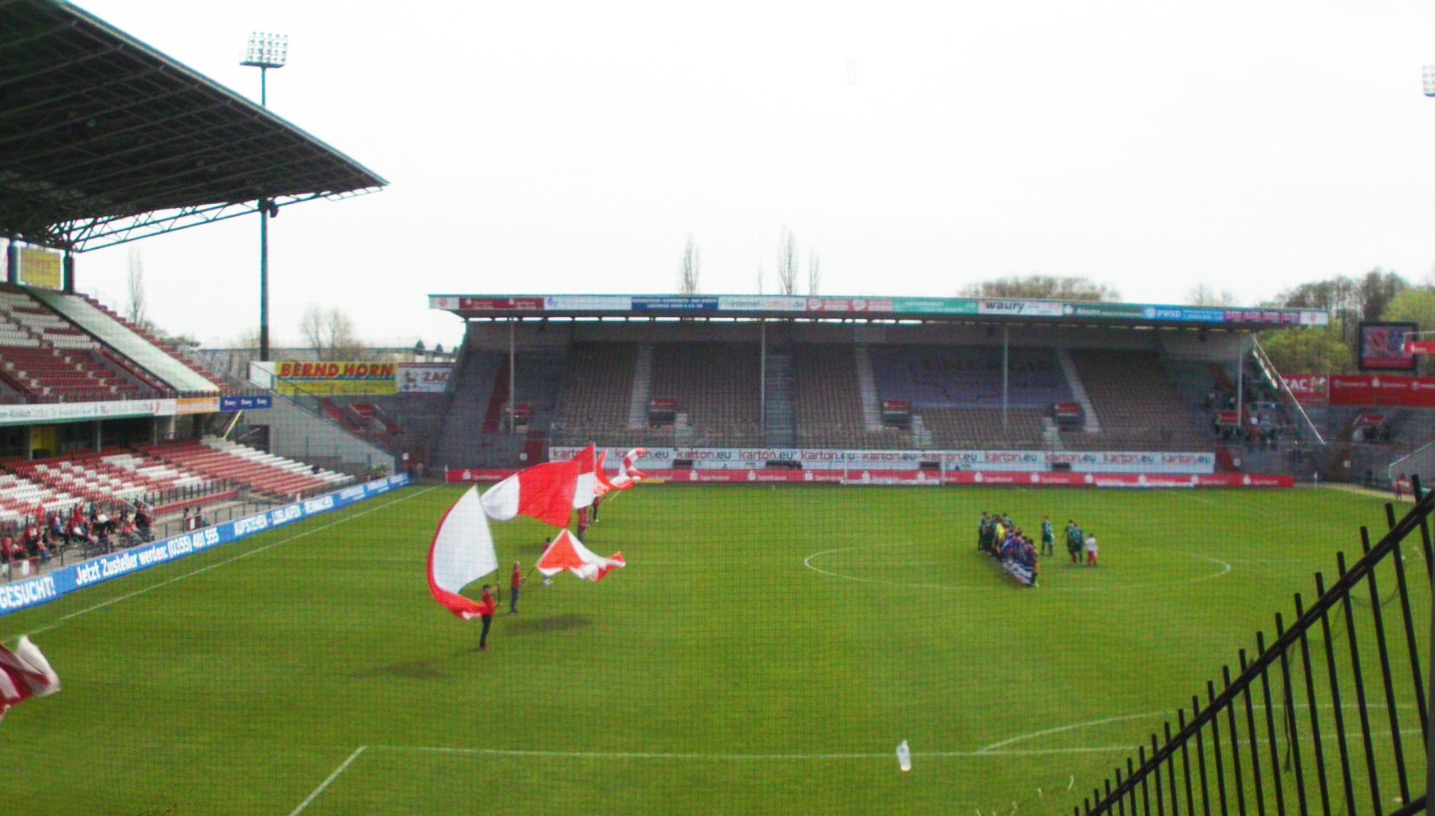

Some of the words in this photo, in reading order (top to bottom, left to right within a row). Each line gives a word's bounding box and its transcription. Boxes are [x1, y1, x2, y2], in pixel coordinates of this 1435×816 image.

[985, 301, 1025, 313] waury
[280, 363, 341, 378] BERND
[344, 363, 393, 377] HORN
[616, 451, 669, 459] kaon.eu
[677, 450, 732, 459] karton.eu
[740, 451, 793, 460] karton.eu
[863, 452, 916, 461] karton.eu
[76, 562, 100, 586] Jetzt
[101, 553, 138, 577] Zusteller
[139, 545, 167, 566] werden:
